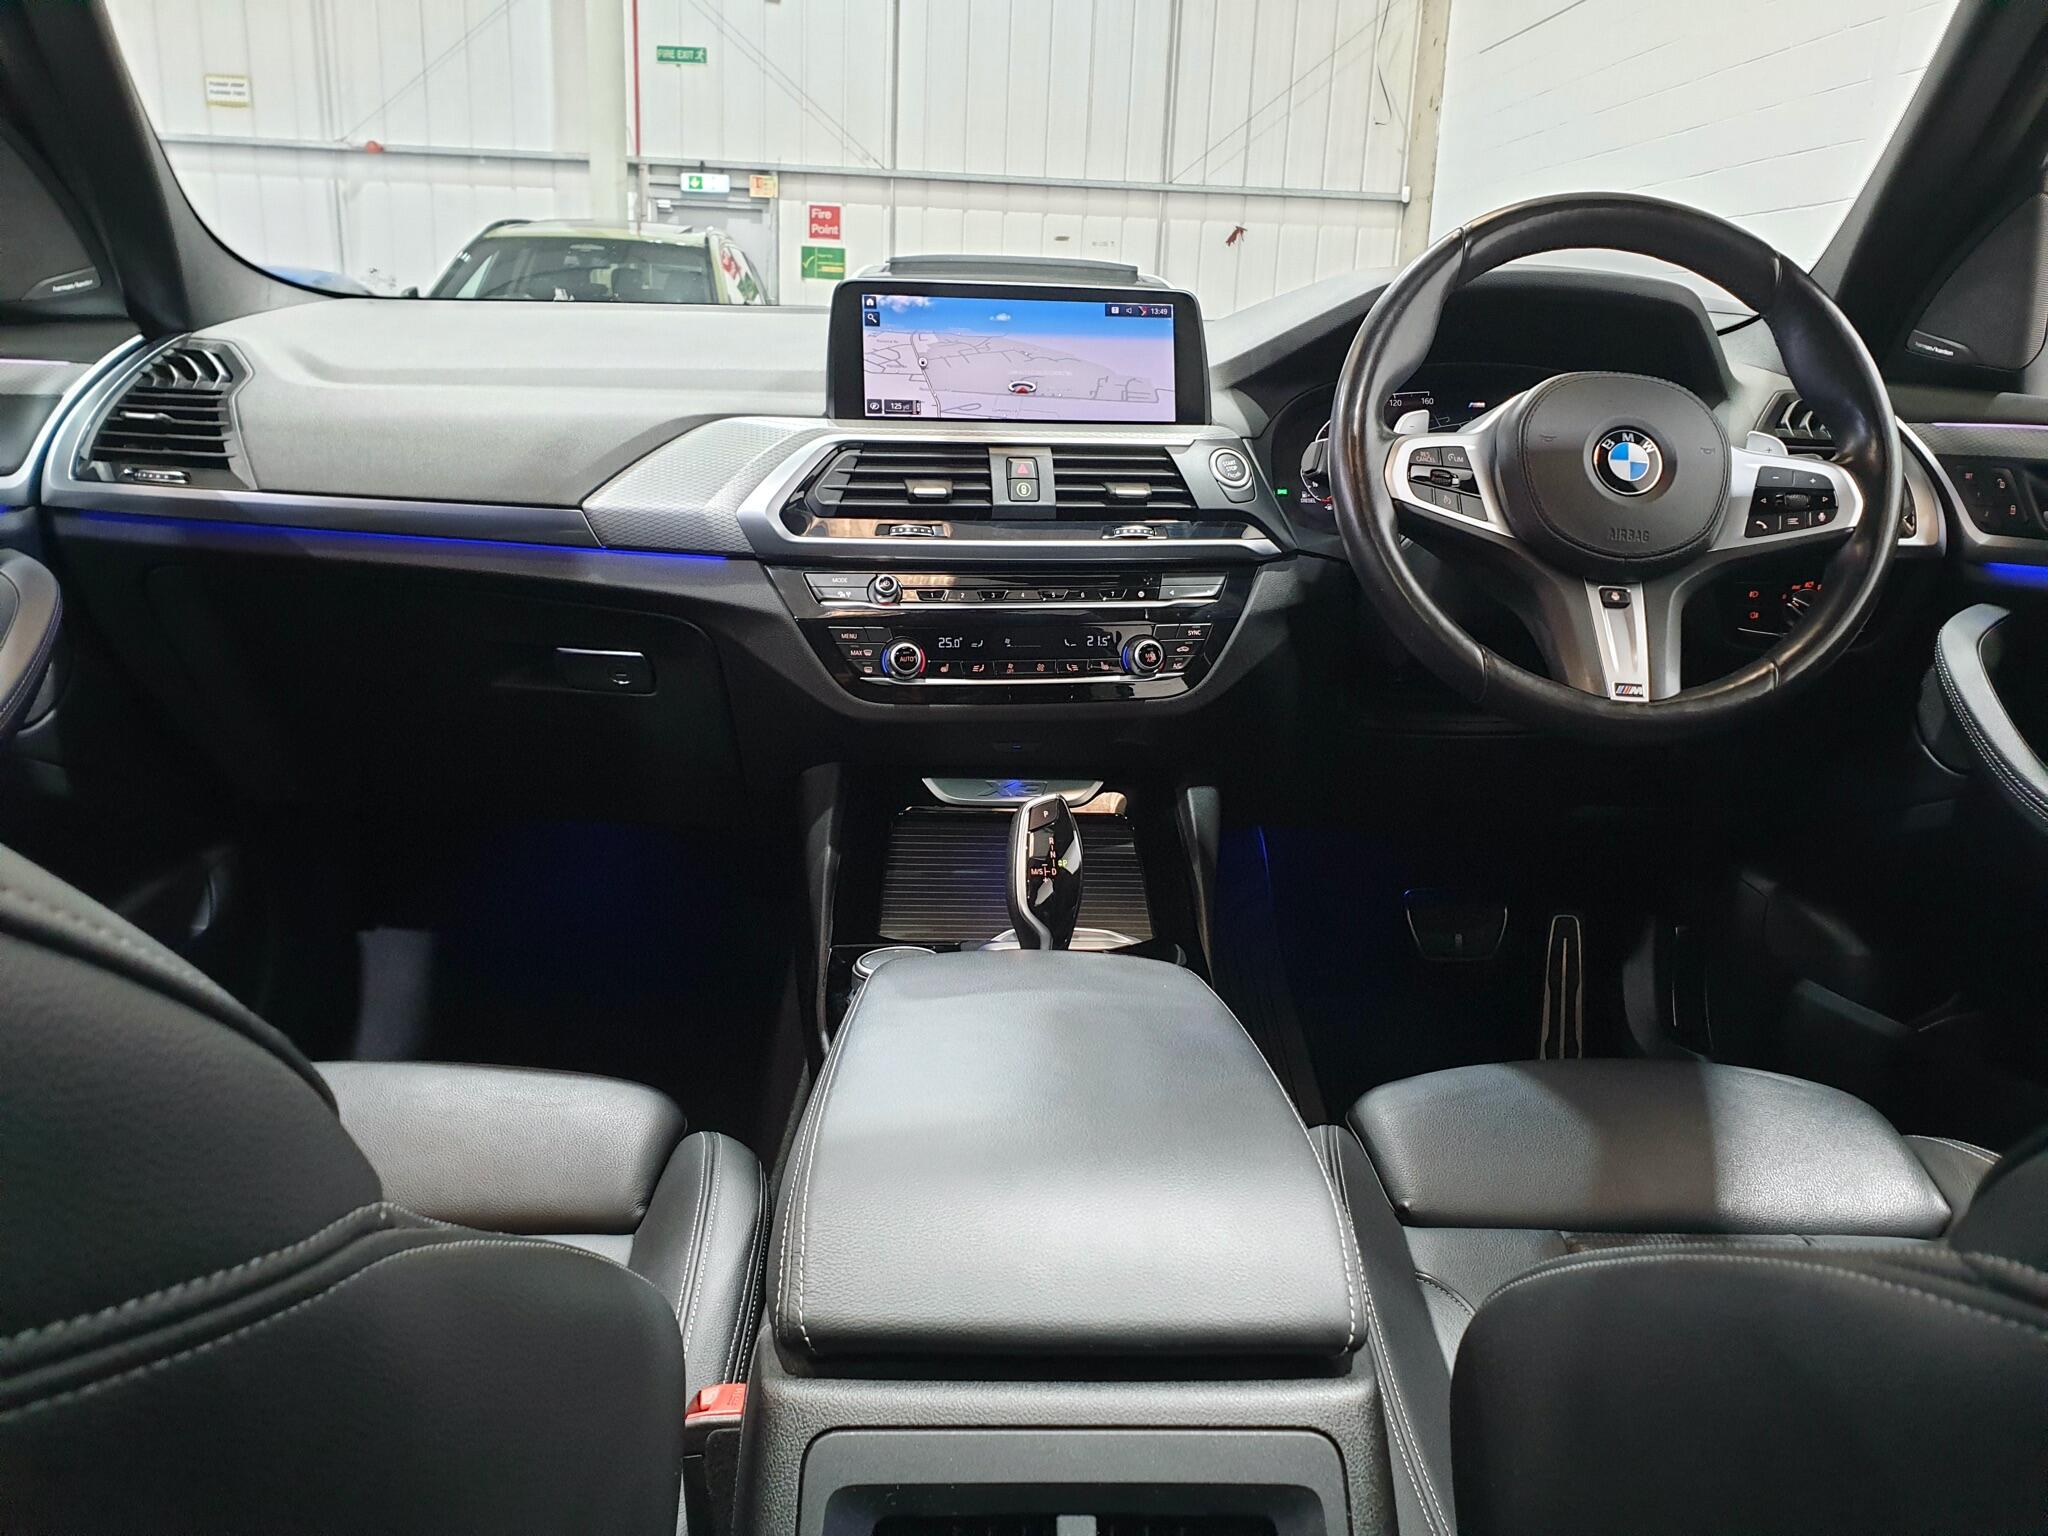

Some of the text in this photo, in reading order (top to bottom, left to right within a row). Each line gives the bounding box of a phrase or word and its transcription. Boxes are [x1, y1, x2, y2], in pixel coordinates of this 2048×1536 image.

[811, 208, 832, 219] Fire
[811, 223, 839, 235] Point
[1150, 307, 1168, 316] 13:49
[890, 402, 903, 411] 125
[1389, 397, 1434, 407] 120 160
[1601, 432, 1655, 453] BMW
[1609, 527, 1650, 543] AIRBAG
[1043, 810, 1049, 818] P
